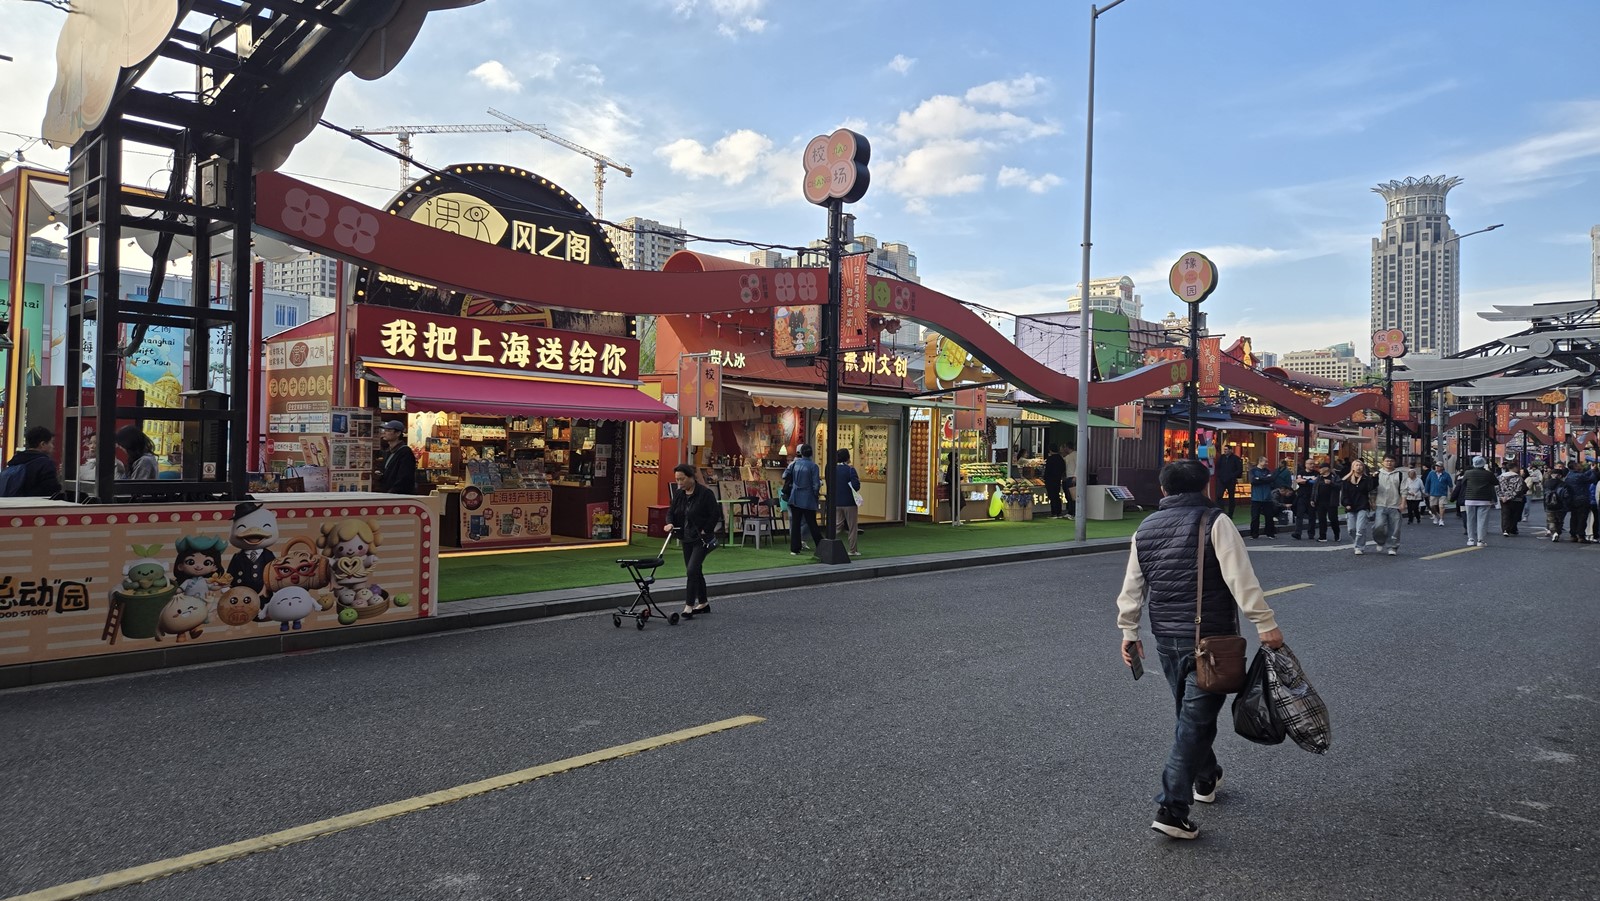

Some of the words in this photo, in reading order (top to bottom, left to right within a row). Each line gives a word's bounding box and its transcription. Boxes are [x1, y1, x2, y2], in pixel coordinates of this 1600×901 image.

[511, 219, 592, 265] 风之阁
[380, 318, 627, 377] 我把上海送给你
[705, 368, 715, 412] 校场
[490, 491, 551, 503] 上海特产伴手礼
[20, 608, 49, 617] STORY
